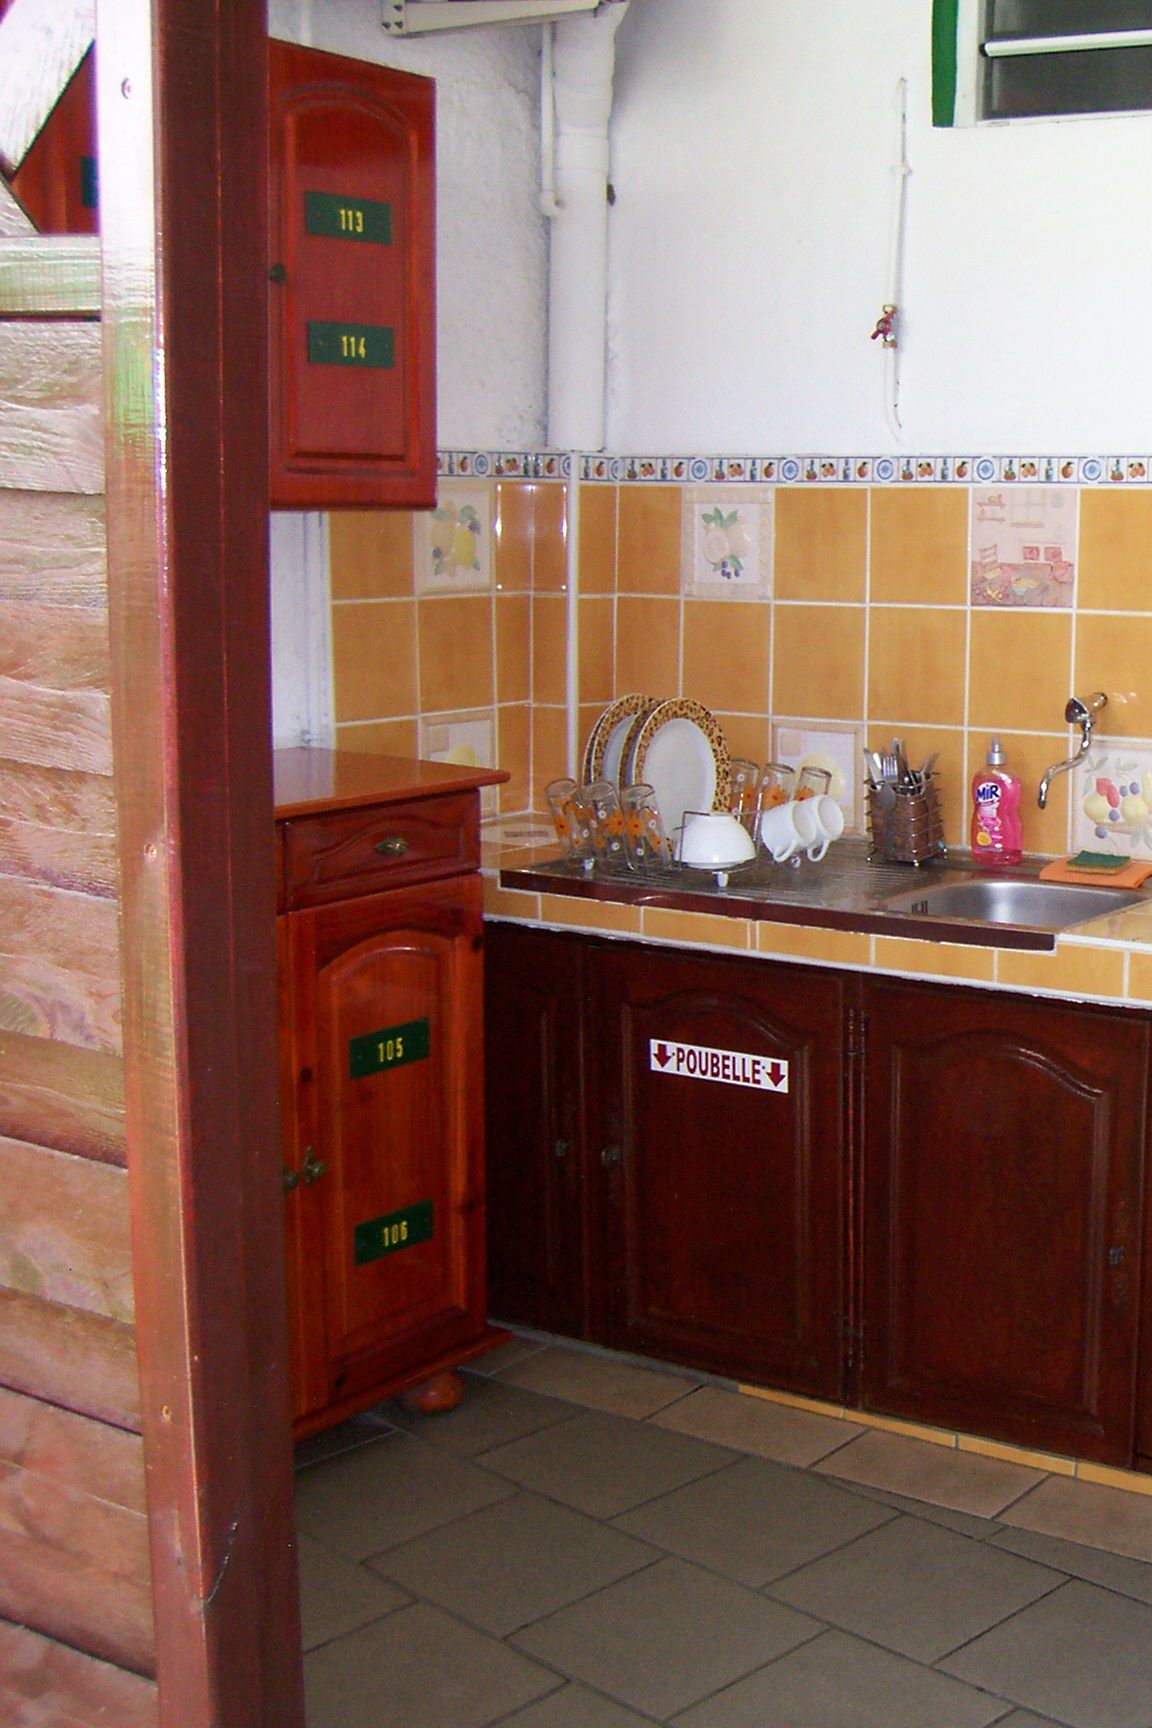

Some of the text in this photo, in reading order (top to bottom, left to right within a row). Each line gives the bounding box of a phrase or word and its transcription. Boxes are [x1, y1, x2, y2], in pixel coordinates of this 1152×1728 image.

[339, 209, 364, 232] 113
[341, 335, 366, 359] 114
[377, 1036, 404, 1063] 105
[676, 1047, 762, 1085] POUBELLE
[383, 1220, 409, 1247] 106
